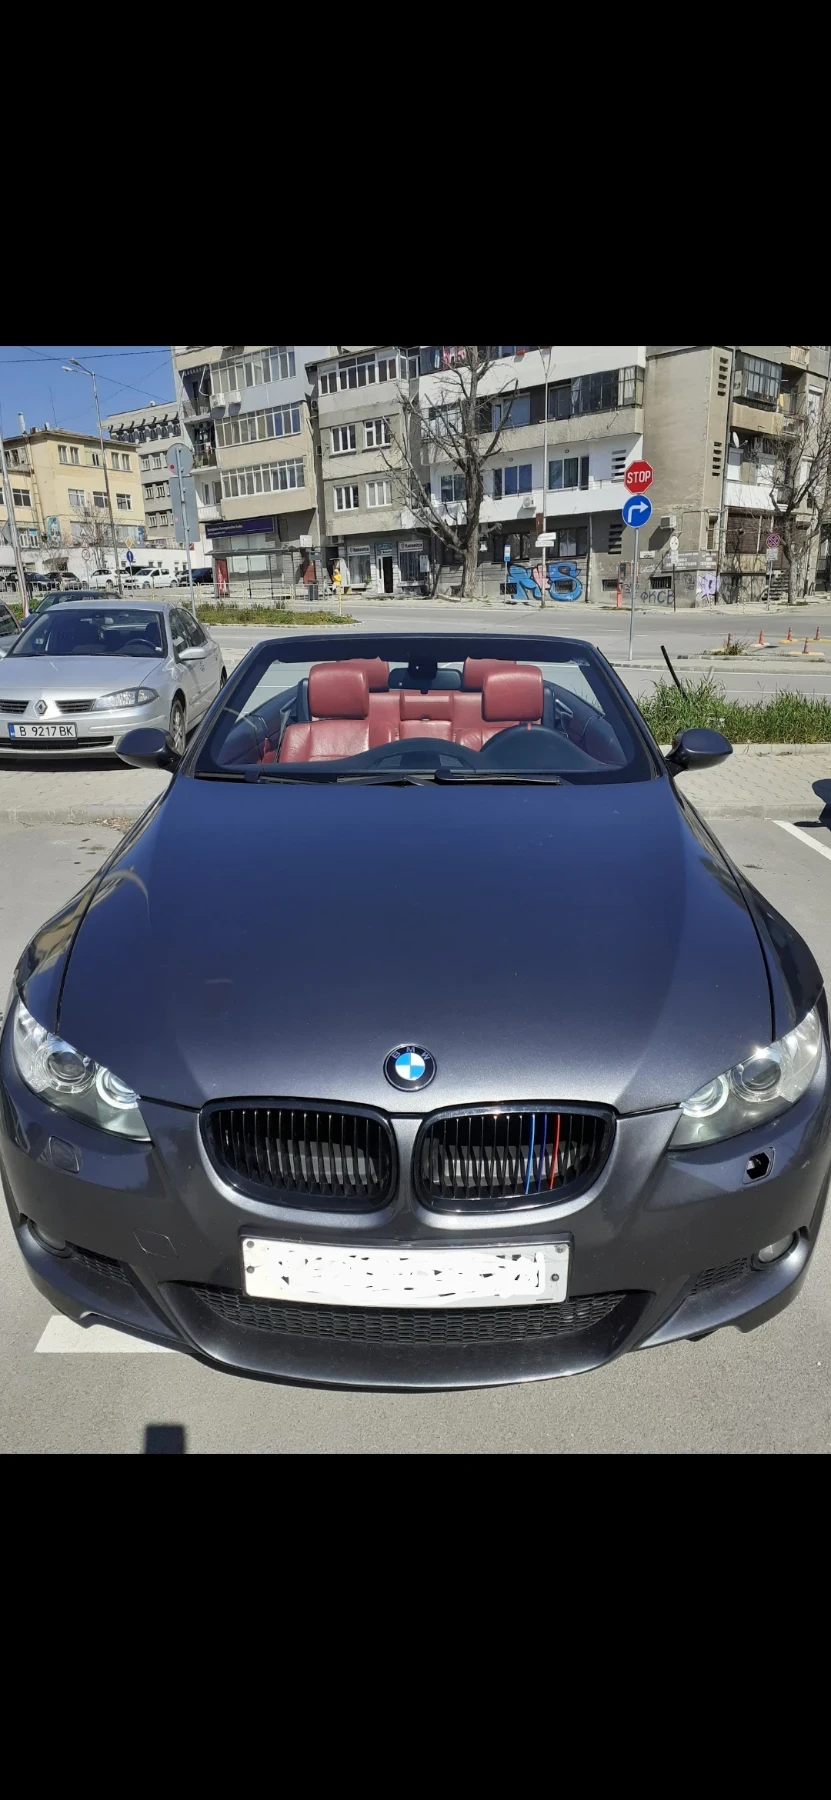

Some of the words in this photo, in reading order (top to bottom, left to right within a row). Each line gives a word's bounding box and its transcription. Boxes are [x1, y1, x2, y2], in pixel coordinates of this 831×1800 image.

[626, 470, 651, 484] STOP
[20, 726, 27, 736] B
[31, 726, 57, 736] 9217
[59, 725, 74, 736] BK
[391, 1046, 431, 1060] BMW
